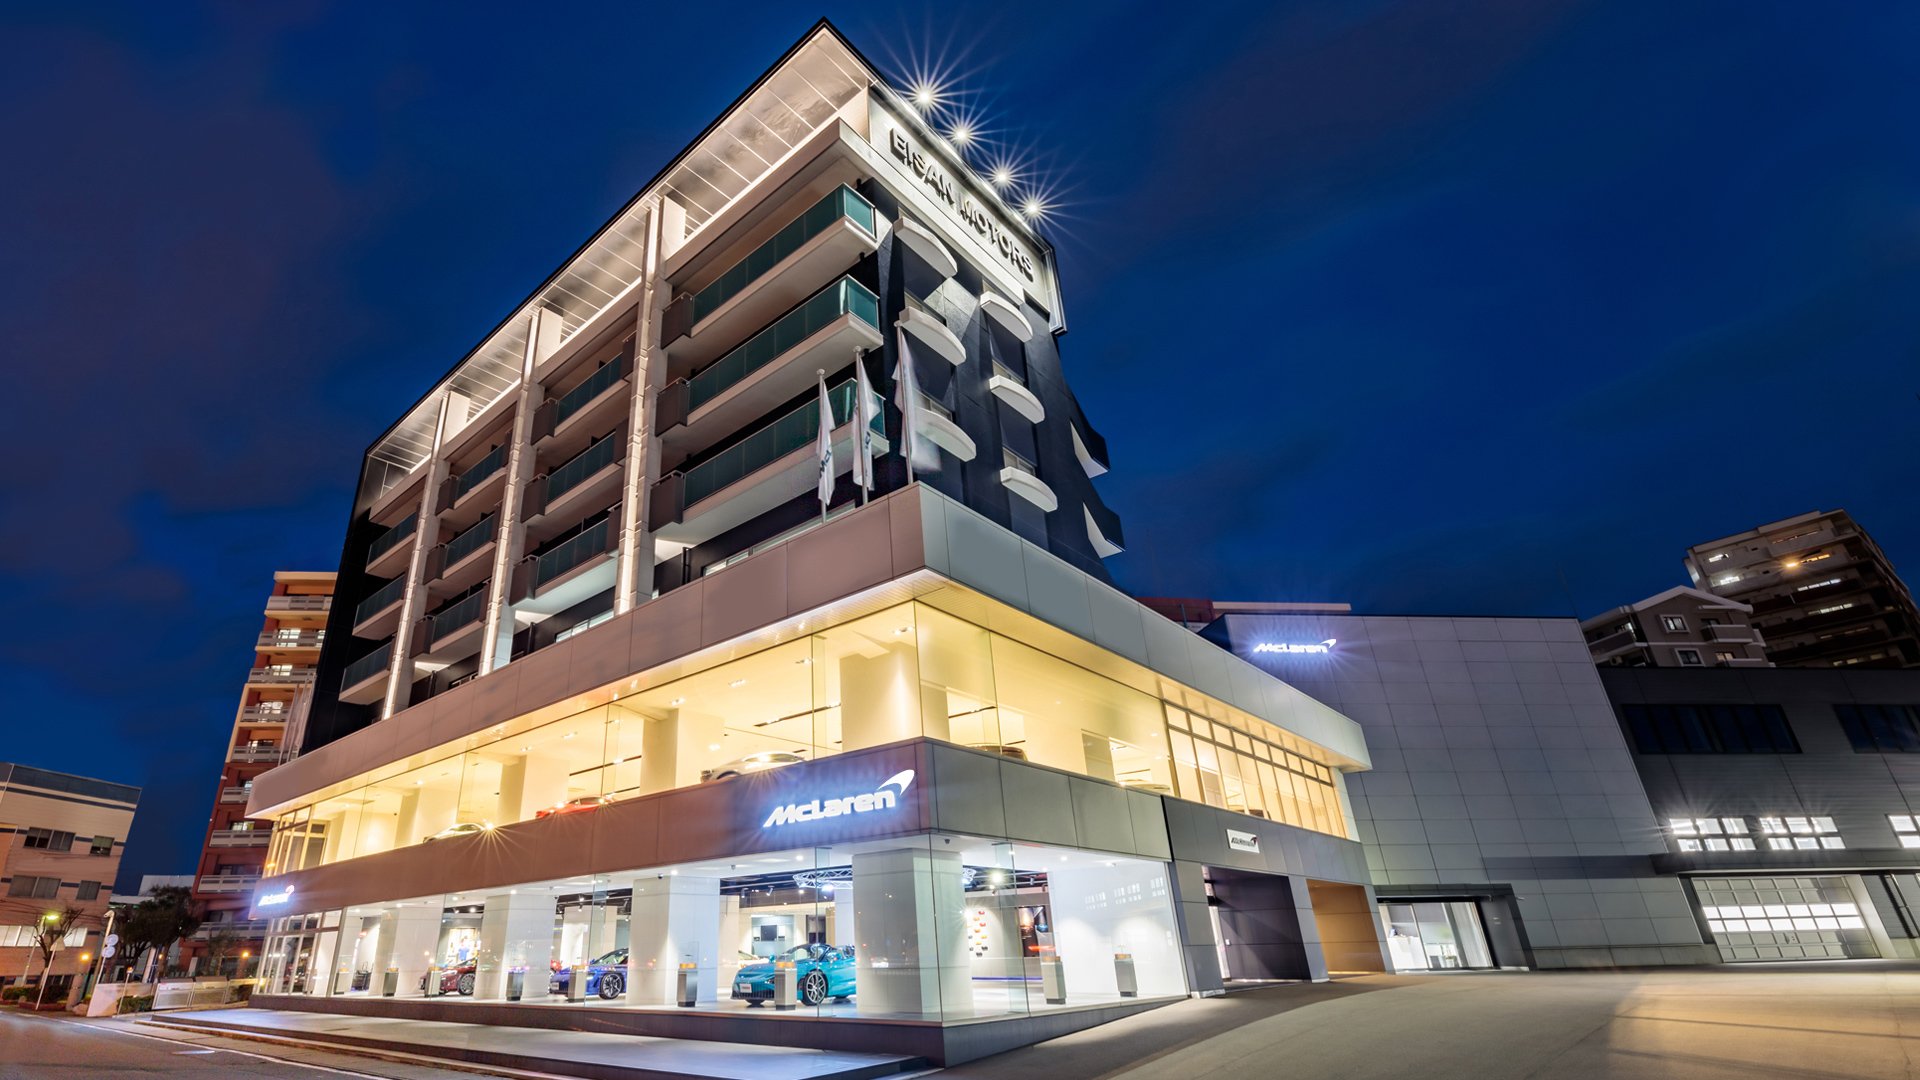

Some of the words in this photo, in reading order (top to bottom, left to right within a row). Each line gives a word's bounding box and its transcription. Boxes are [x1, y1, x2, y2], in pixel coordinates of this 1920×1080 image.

[890, 127, 954, 205] EISAN
[960, 199, 1034, 283] MOTORS
[763, 790, 896, 828] McLaren
